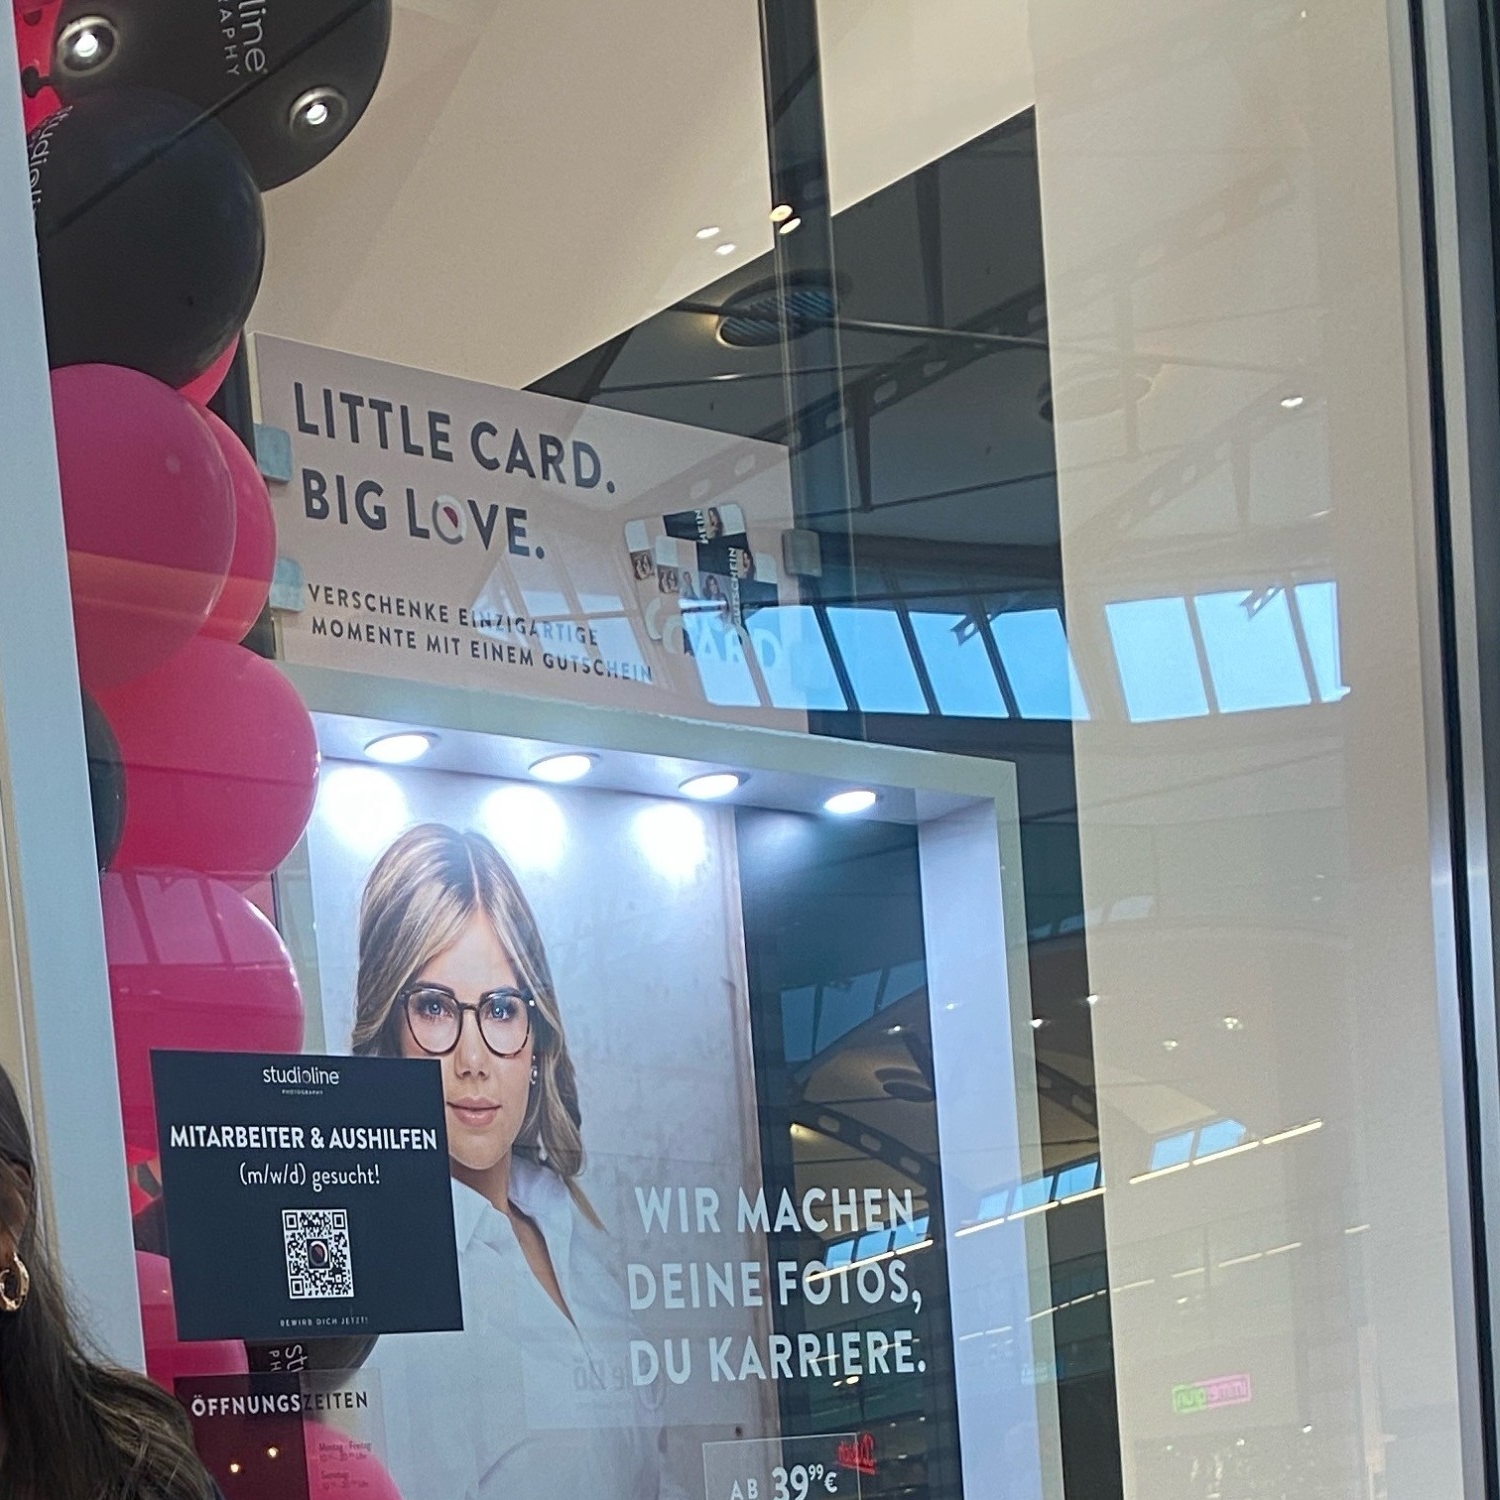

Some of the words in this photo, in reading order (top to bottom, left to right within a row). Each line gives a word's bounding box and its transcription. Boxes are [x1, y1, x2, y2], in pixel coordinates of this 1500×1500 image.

[294, 382, 453, 461] LITTLE
[472, 421, 616, 493] CARD.
[302, 467, 386, 530] BIG
[406, 487, 545, 560] LOVE.
[309, 584, 449, 626] VERSCHENKE
[458, 605, 598, 647] EINZIGARTIGE
[312, 620, 417, 650] MOMENTE
[426, 636, 460, 655] MIT
[470, 641, 535, 668] EINEM
[543, 654, 651, 684] GUTSCHEIN
[263, 1065, 340, 1085] studioline
[170, 1125, 304, 1150] MITARBEITER
[310, 1127, 325, 1149] &
[329, 1127, 437, 1151] AUSHILFEN
[239, 1162, 307, 1186] (m/w/d)
[312, 1164, 380, 1192] gesucht!
[635, 1187, 720, 1234] WIR
[737, 1187, 913, 1233] MACHEN
[628, 1263, 762, 1310] DEINE
[779, 1259, 921, 1314] FOTOS,
[631, 1339, 691, 1385] DU
[710, 1330, 925, 1381] KARRIERE.
[192, 1391, 368, 1417] ÖFFNUNGSZEITEN
